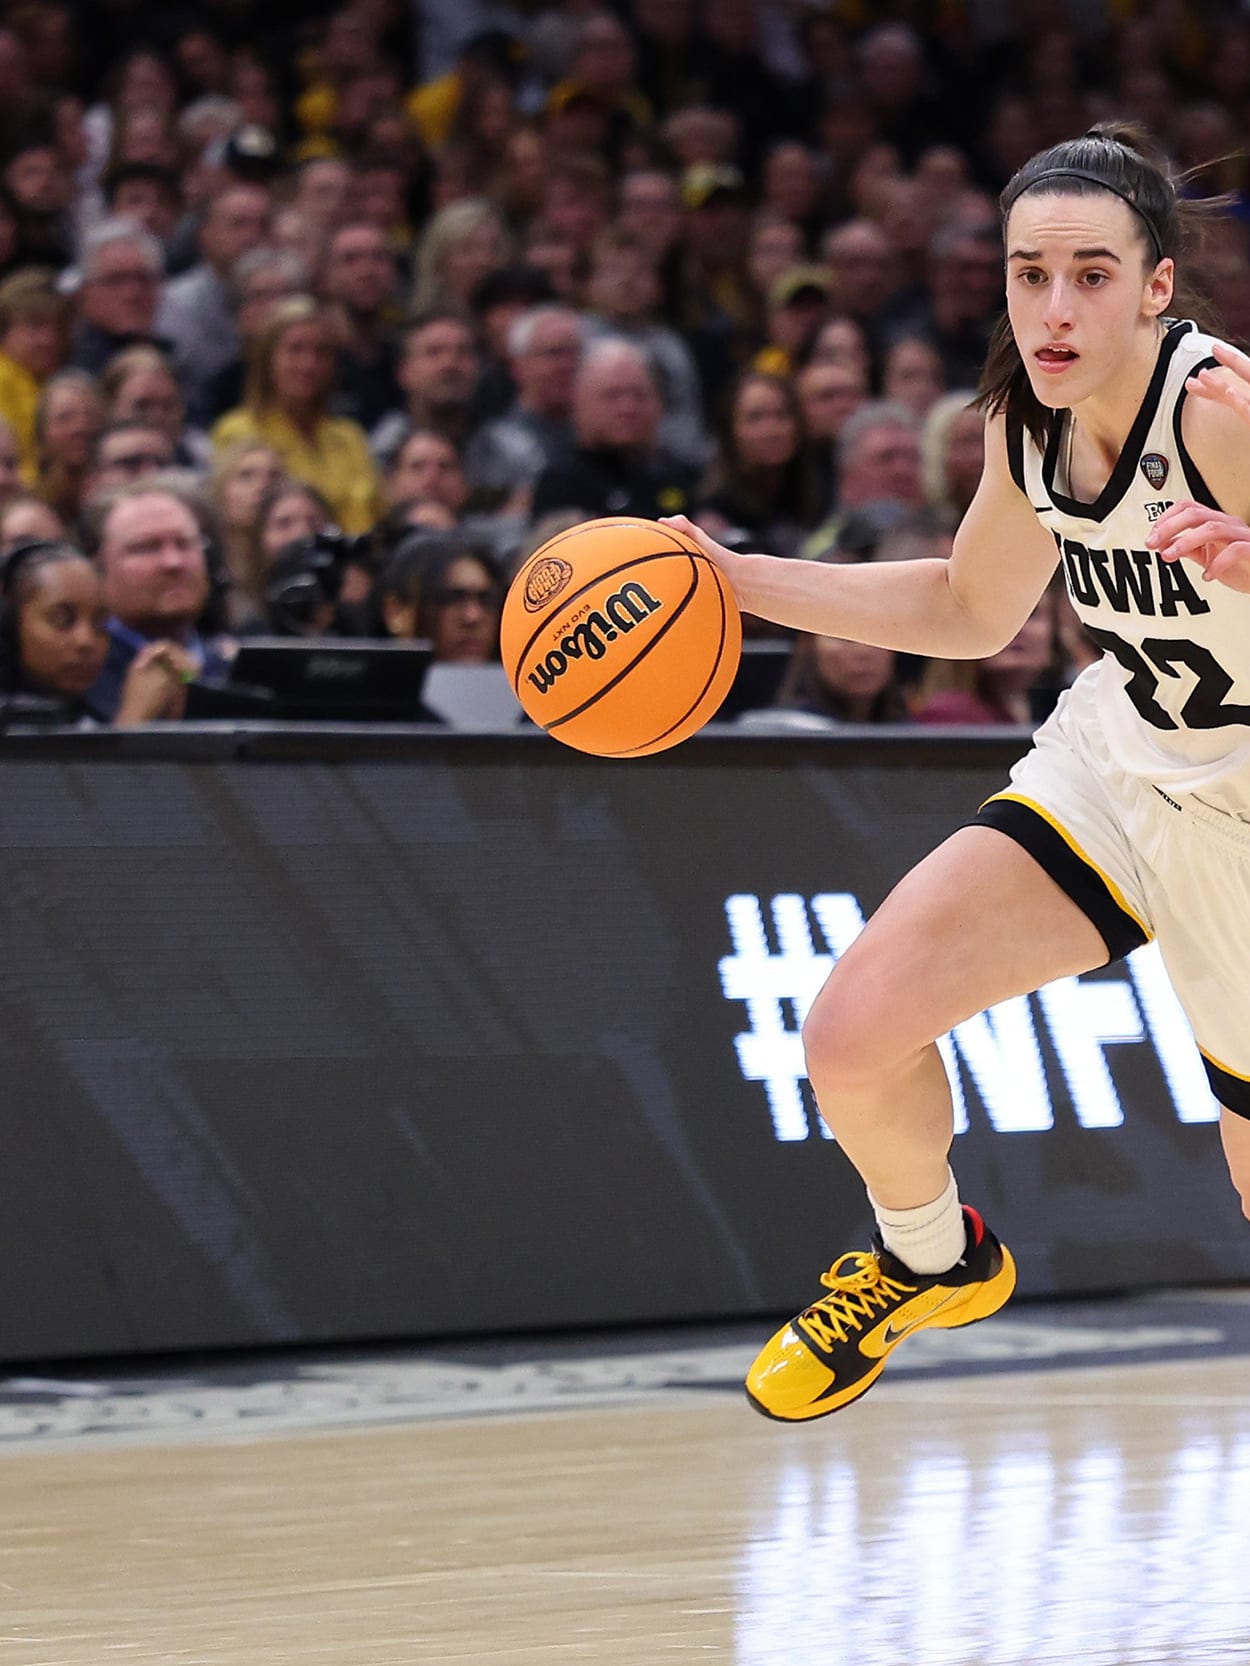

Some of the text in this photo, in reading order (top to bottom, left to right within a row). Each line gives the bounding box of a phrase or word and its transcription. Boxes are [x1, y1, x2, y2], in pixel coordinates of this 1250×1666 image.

[528, 582, 662, 694] Wilson
[552, 604, 591, 641] EVO NXT
